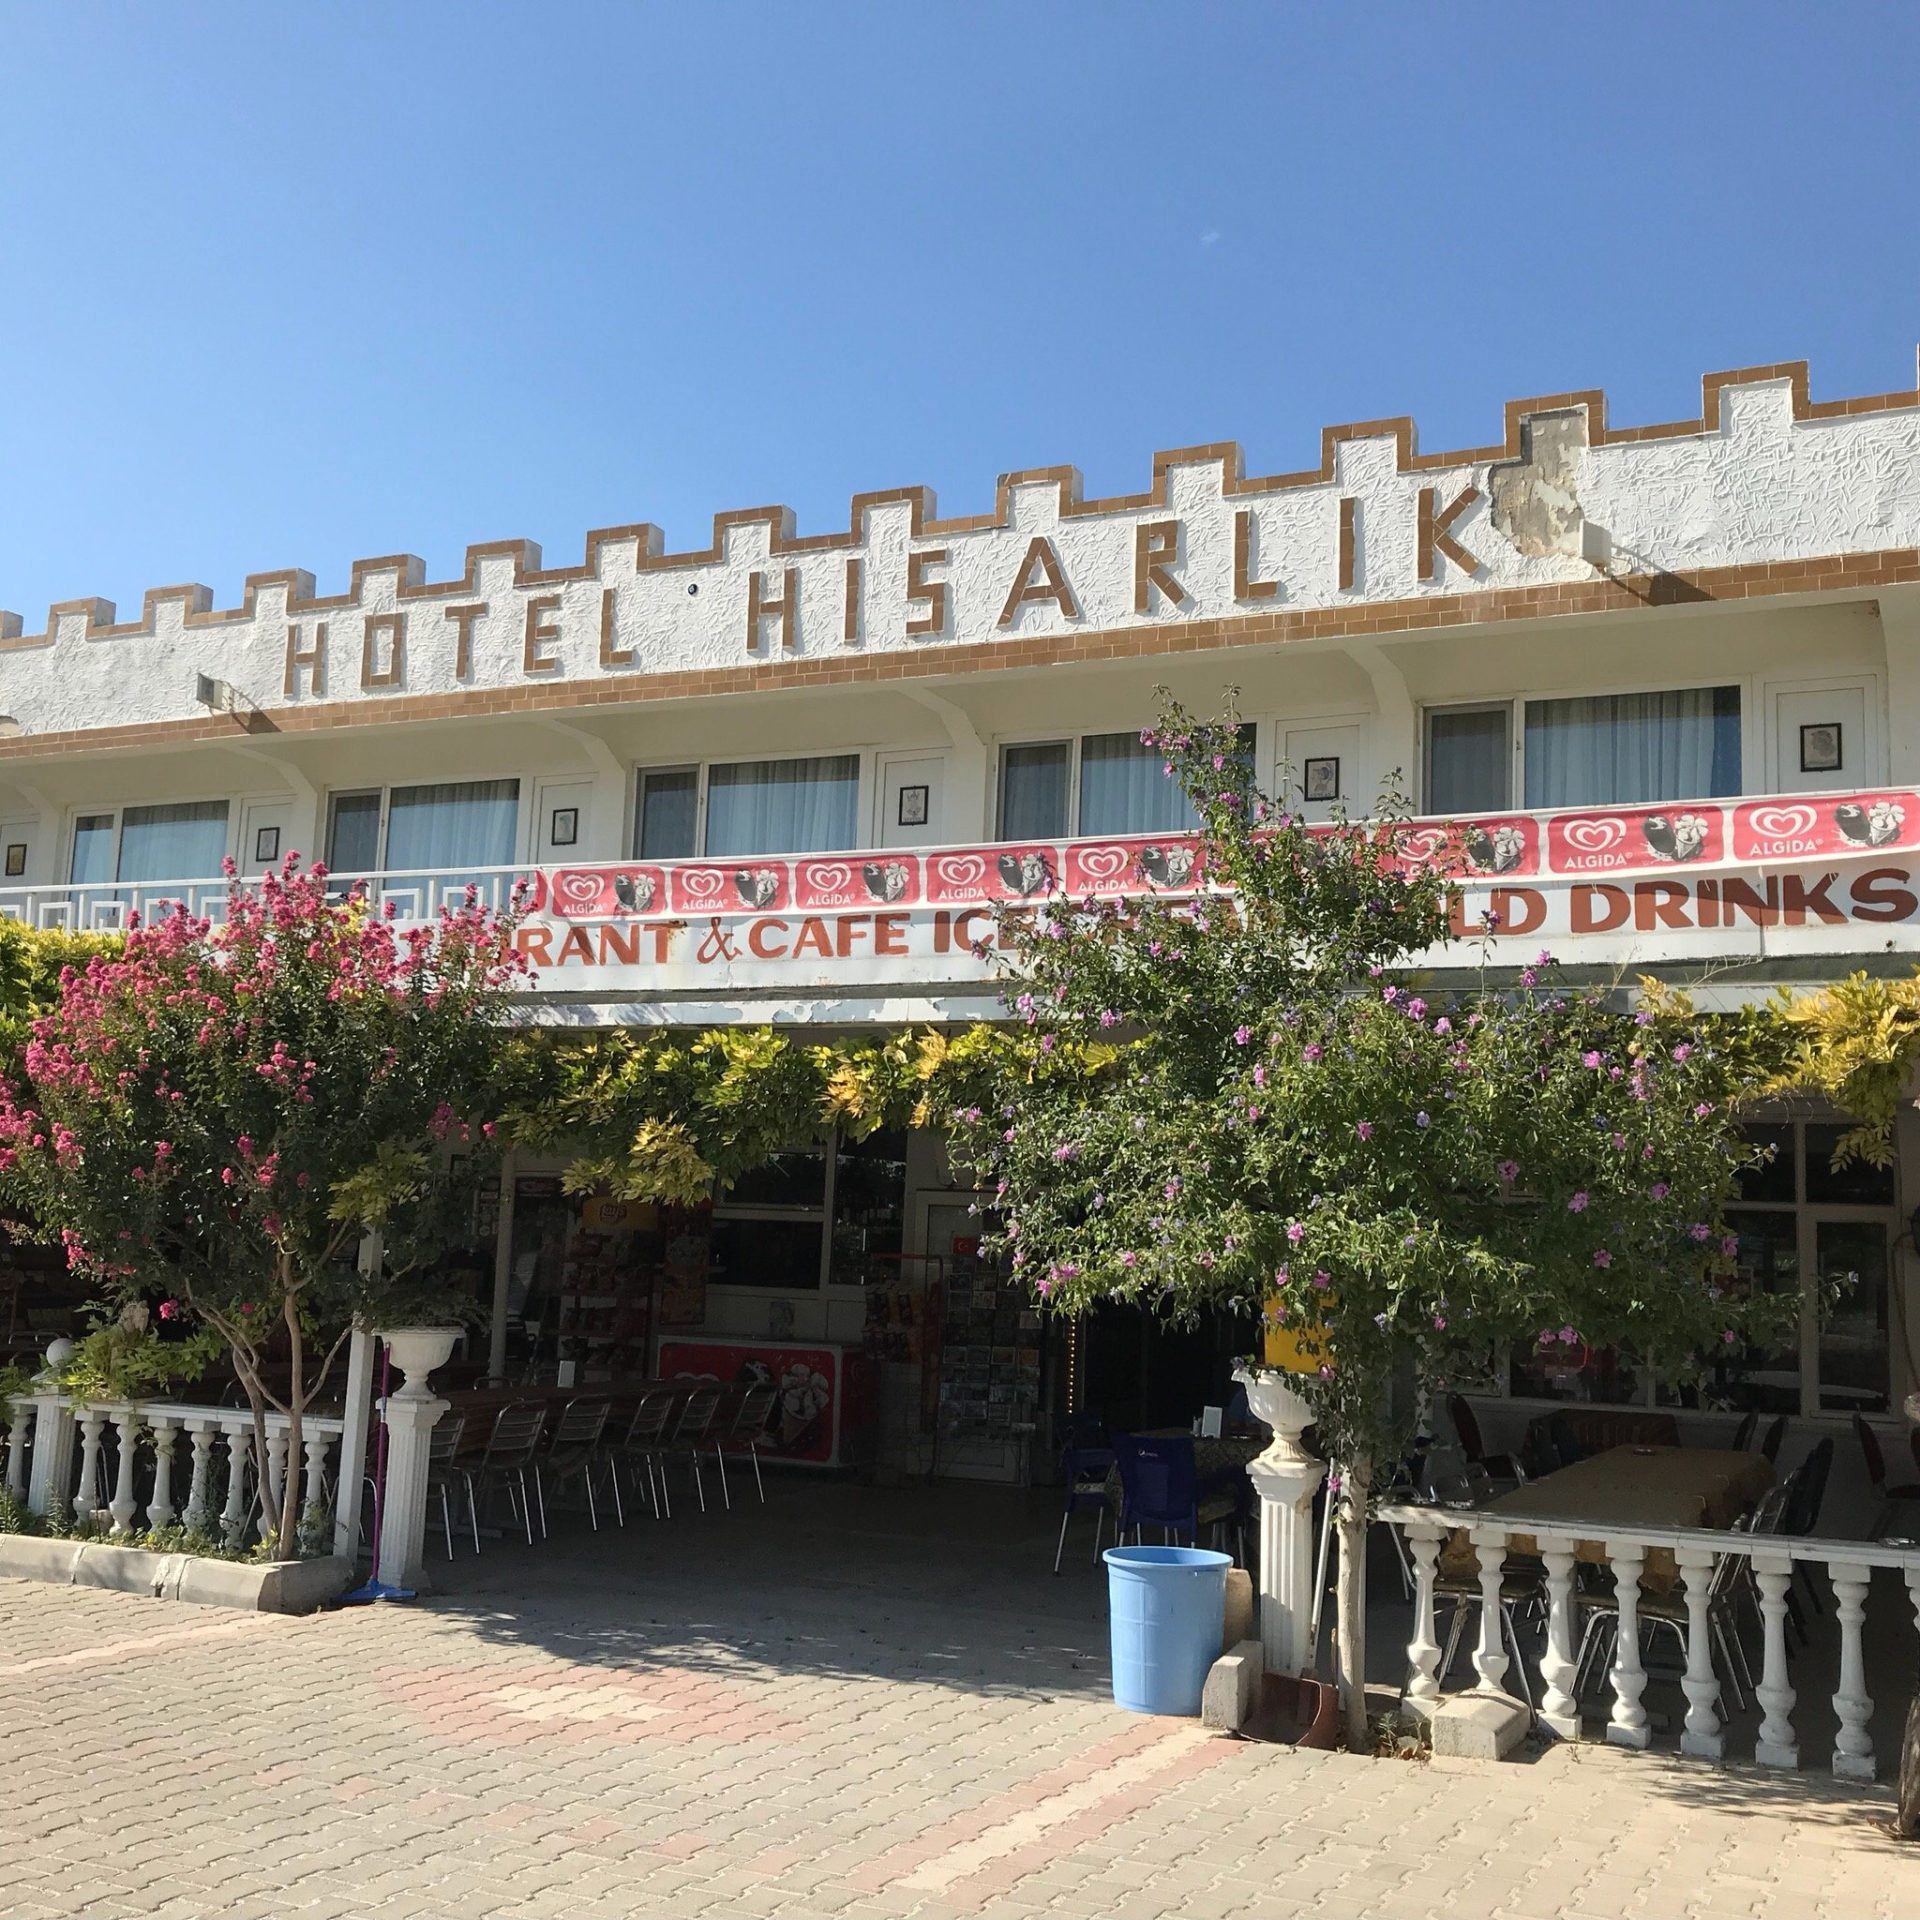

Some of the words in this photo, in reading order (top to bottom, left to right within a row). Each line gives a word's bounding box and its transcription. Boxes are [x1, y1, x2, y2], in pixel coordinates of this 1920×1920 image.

[284, 588, 634, 697] HOTEL
[747, 483, 1481, 651] HISARLIK
[697, 917, 742, 963] &
[748, 911, 909, 959] CAFE
[1570, 868, 1919, 934] DRINKS
